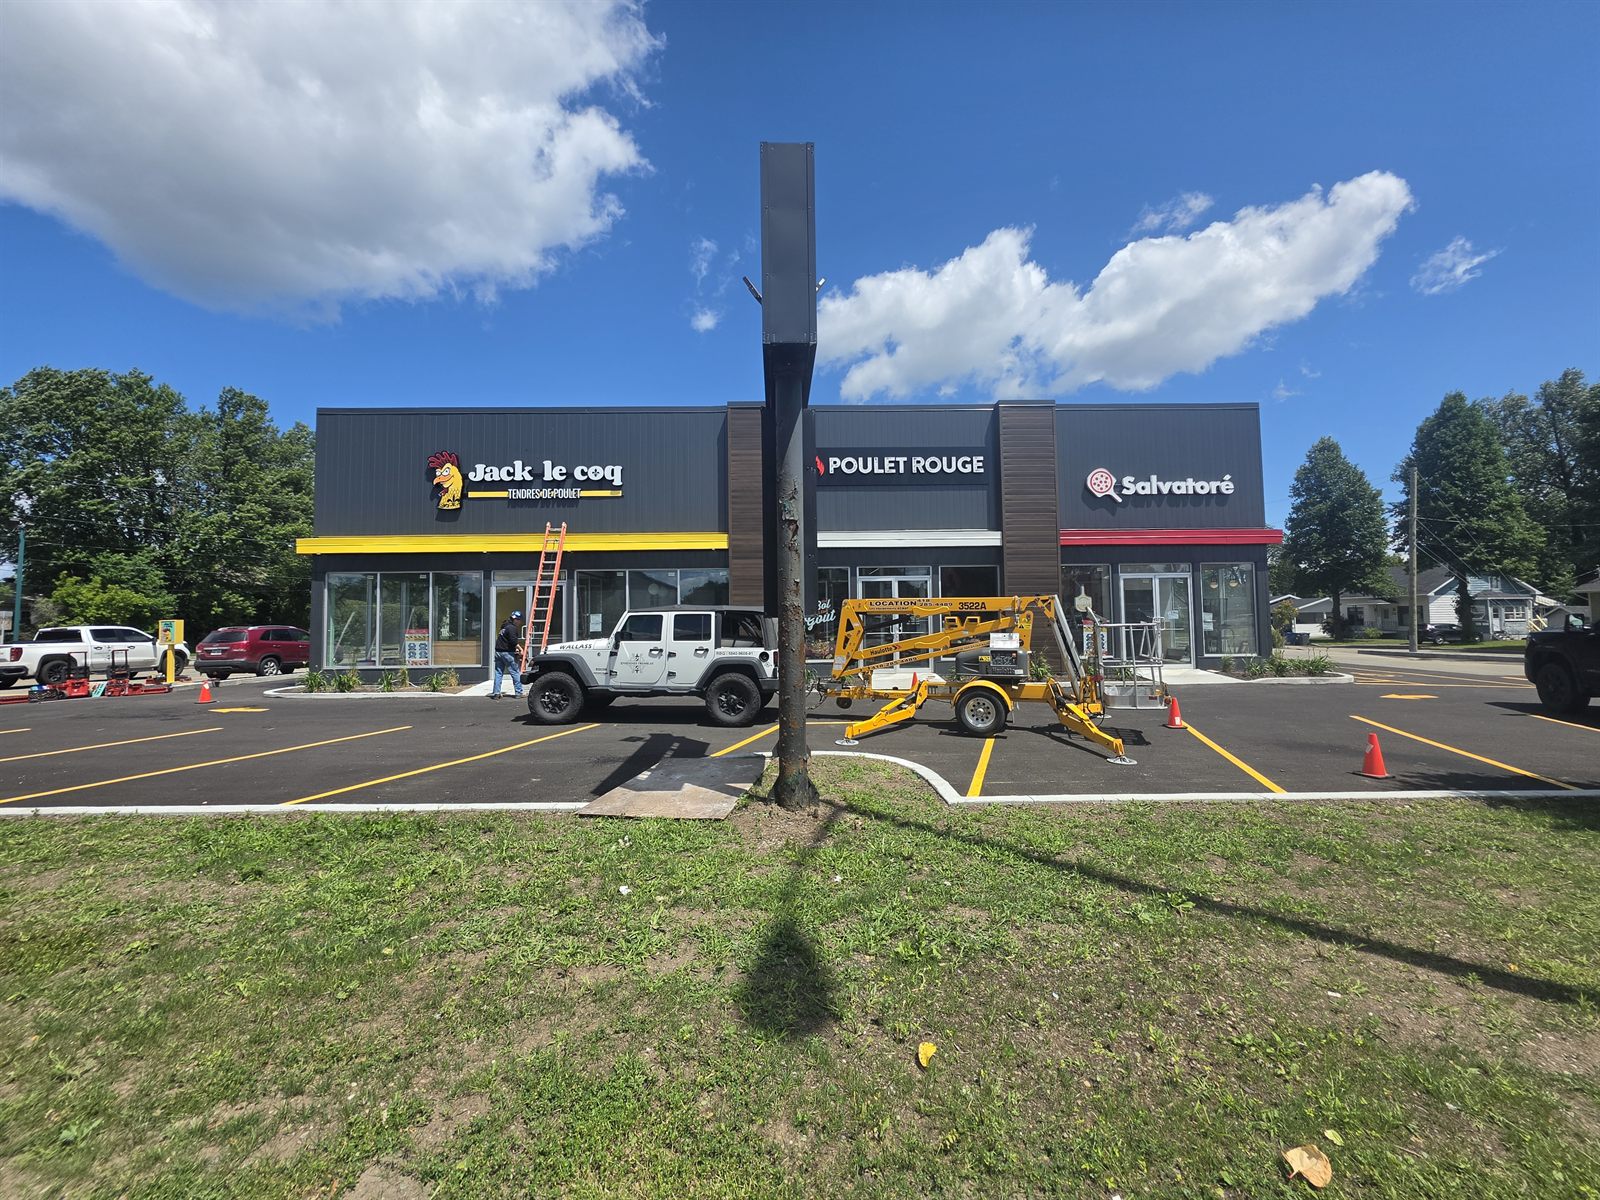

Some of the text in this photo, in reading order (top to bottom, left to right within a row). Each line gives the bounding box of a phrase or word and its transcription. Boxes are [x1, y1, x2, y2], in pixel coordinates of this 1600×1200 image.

[828, 455, 985, 474] POULET ROUGE
[468, 460, 623, 486] Jack le coq
[1121, 474, 1235, 496] Salvatoré
[507, 488, 582, 500] TENDRES DE POULET
[958, 601, 987, 611] 3522A
[869, 646, 894, 656] Haulotte
